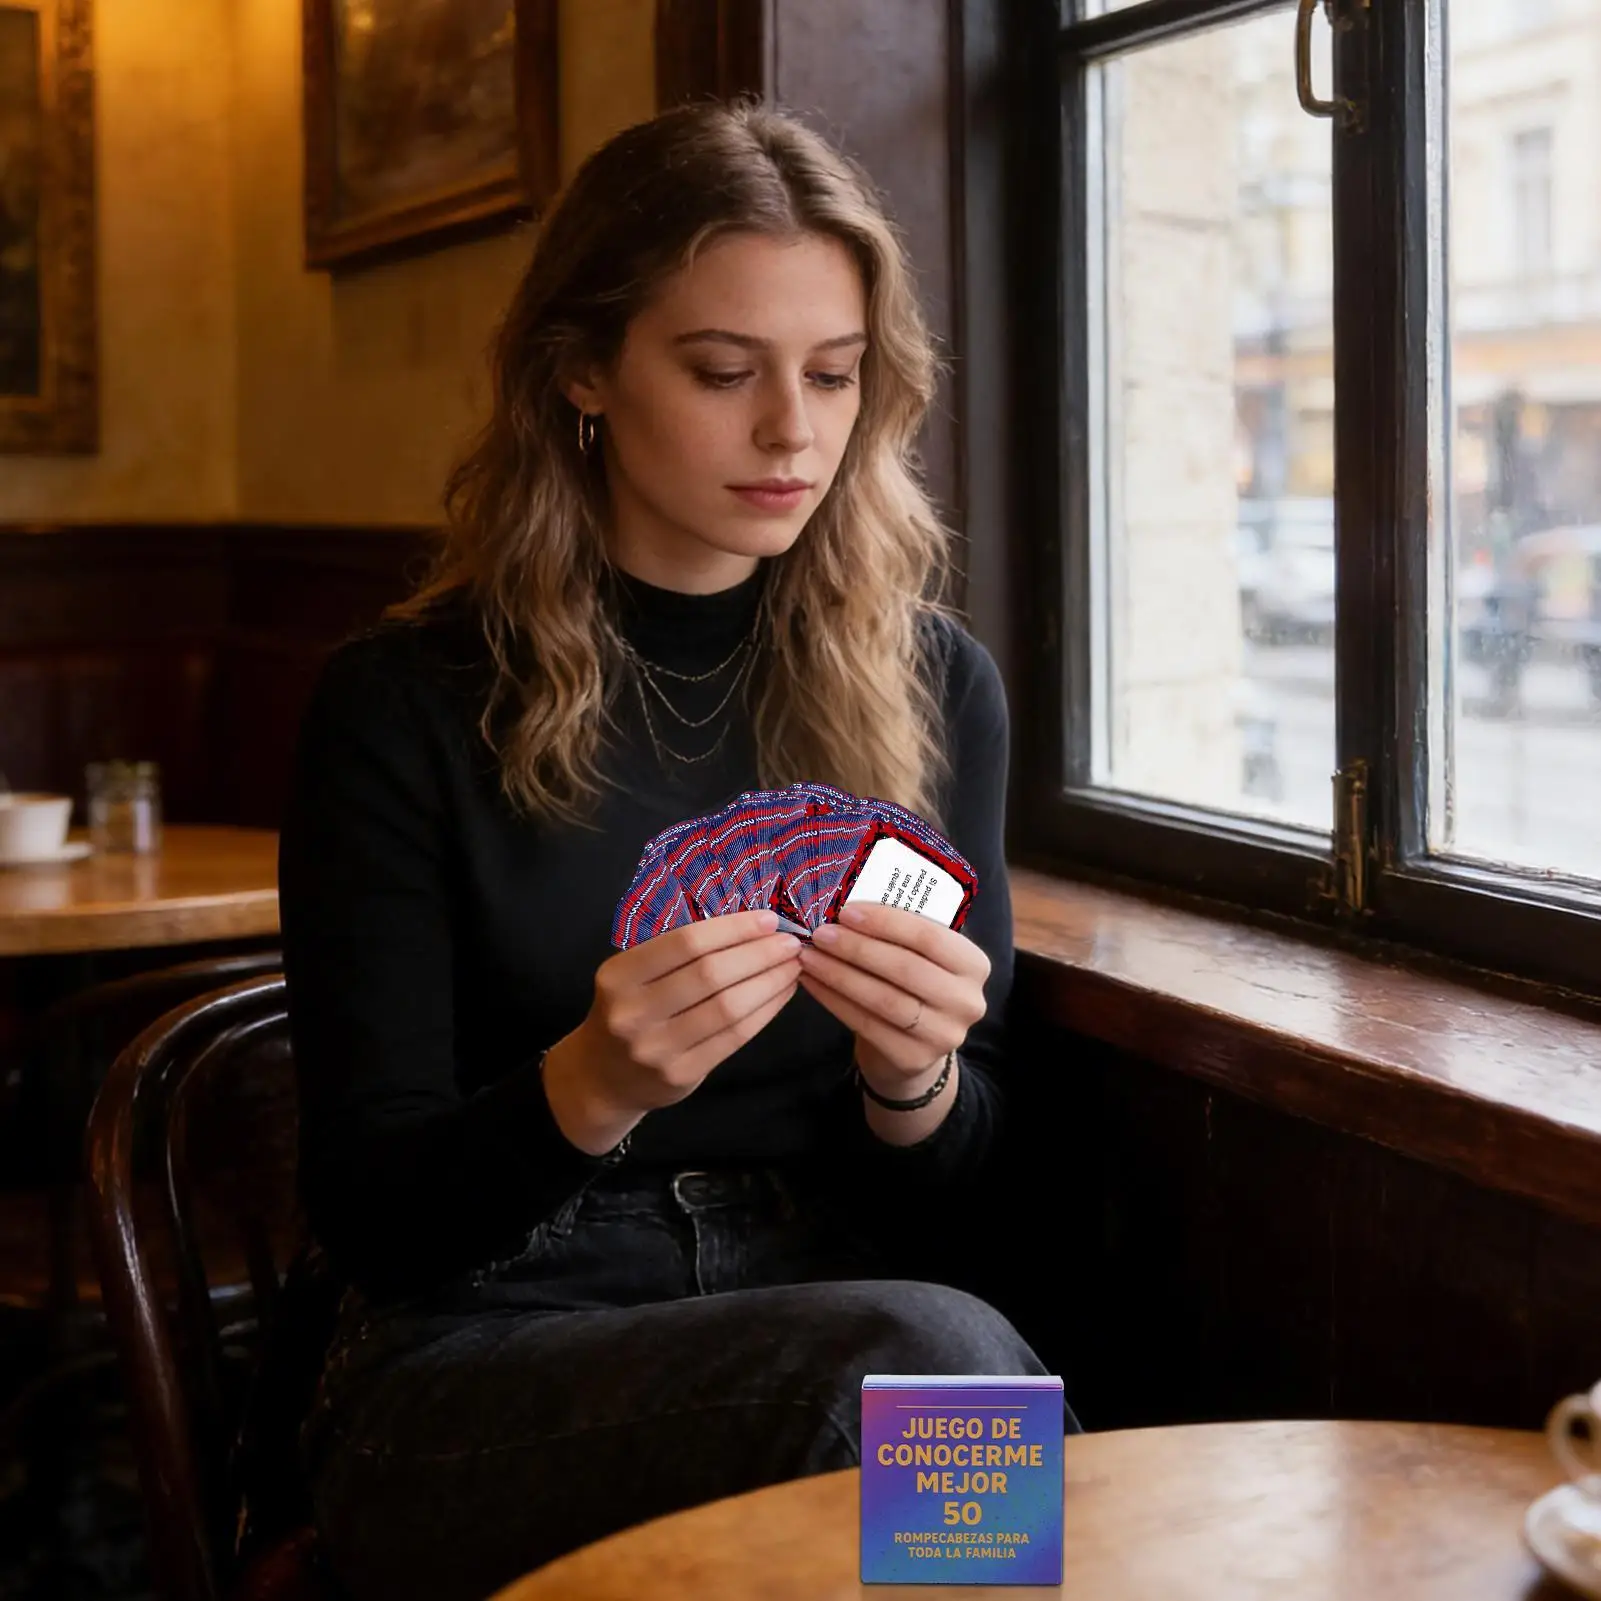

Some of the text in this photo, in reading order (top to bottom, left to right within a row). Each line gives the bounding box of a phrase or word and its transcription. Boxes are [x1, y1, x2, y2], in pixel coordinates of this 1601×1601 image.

[901, 874, 912, 888] una
[911, 869, 927, 896] pasado
[929, 877, 938, 886] Si
[902, 1417, 1022, 1439] JUEGO DE
[877, 1444, 1043, 1467] CONOCERME
[916, 1471, 1008, 1494] MEJOR
[943, 1501, 982, 1526] 50
[894, 1532, 1030, 1544] ROMPECABEZAS PARA
[908, 1547, 1016, 1559] TODA LA FAMILIA
